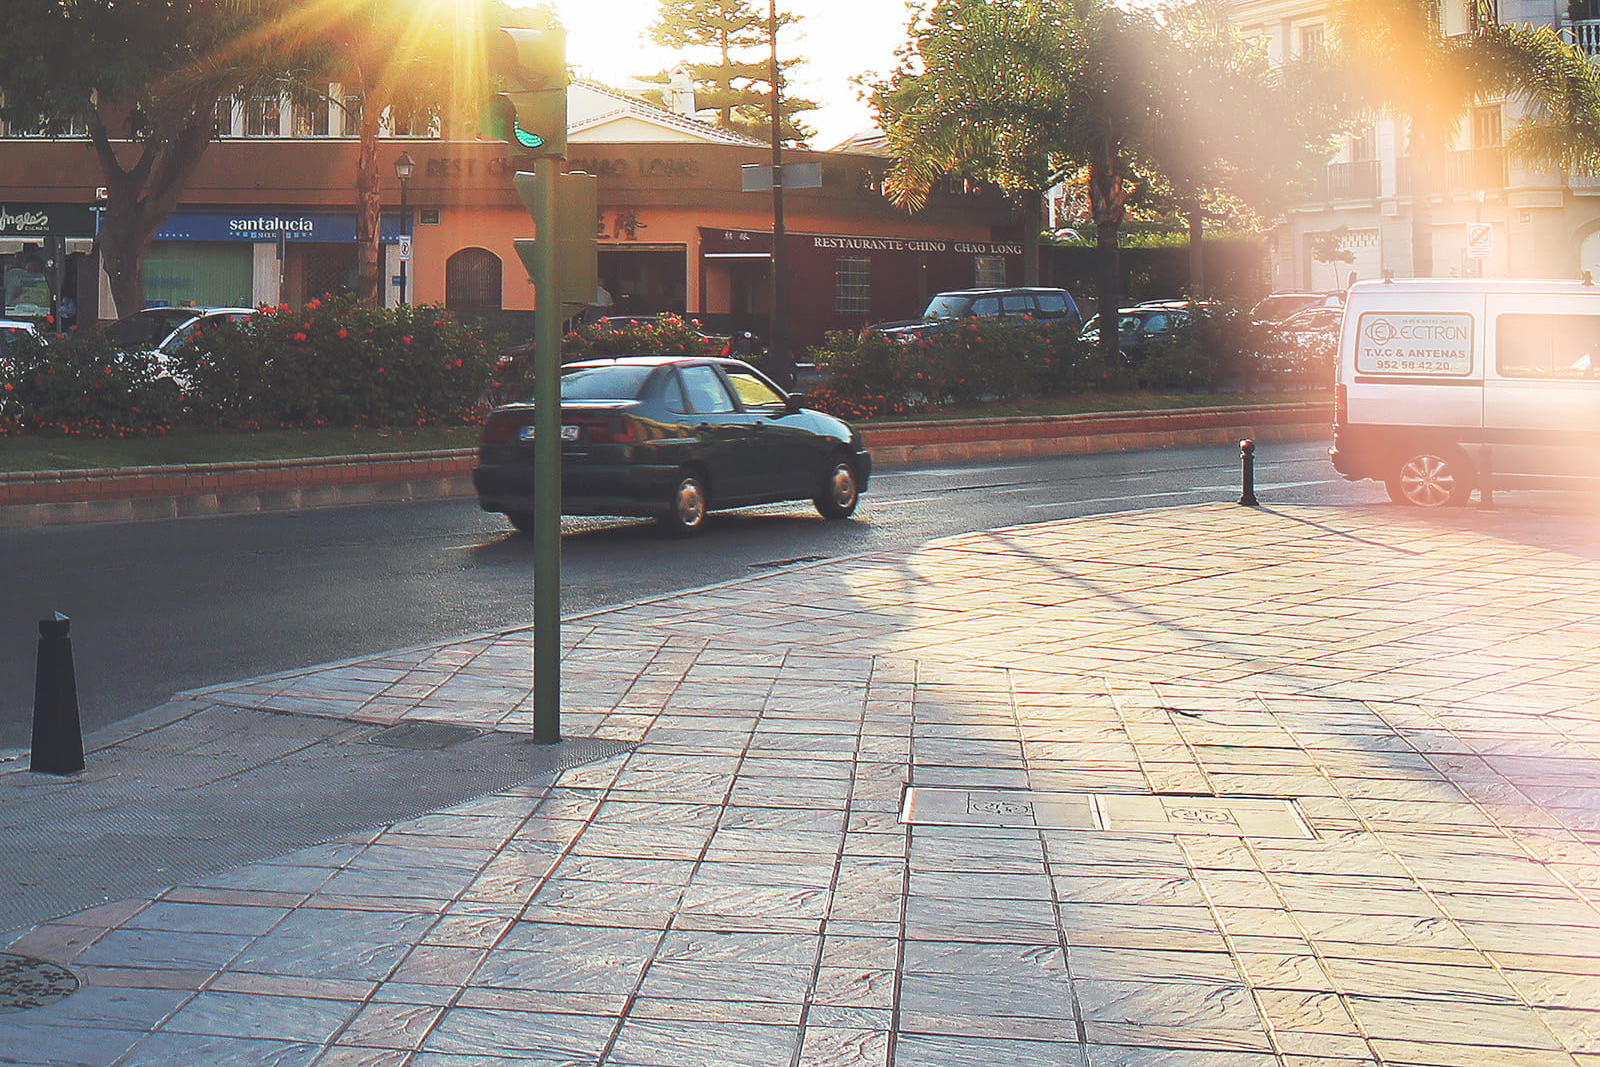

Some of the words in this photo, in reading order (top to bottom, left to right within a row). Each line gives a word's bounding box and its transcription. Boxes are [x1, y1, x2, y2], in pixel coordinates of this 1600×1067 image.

[229, 217, 313, 231] santalucía
[814, 237, 903, 251] RESTAURANTE
[954, 243, 986, 254] CHAO
[991, 244, 1023, 255] LONG
[1407, 349, 1466, 359] ANTENAS
[1376, 360, 1398, 369] 952
[1401, 361, 1415, 369] 58
